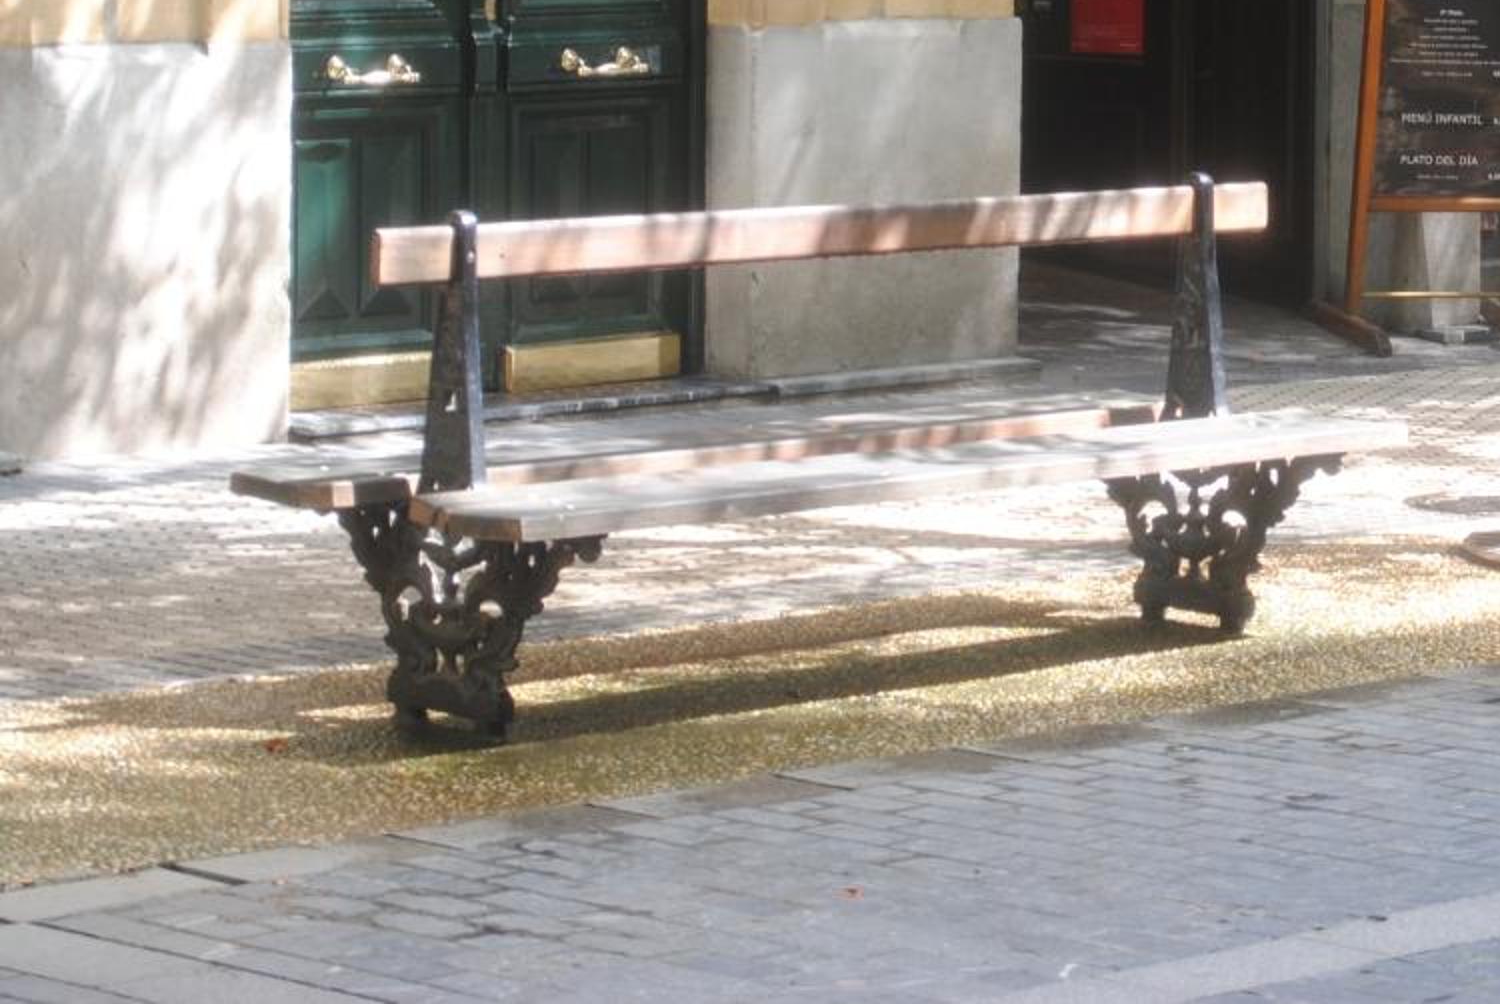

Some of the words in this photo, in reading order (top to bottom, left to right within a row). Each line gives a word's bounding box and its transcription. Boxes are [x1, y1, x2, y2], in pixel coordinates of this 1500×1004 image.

[1401, 110, 1433, 125] MENÚ
[1435, 112, 1484, 126] INFANTIL
[1400, 154, 1434, 166] PLATO
[1435, 155, 1457, 166] DEL
[1458, 153, 1479, 166] DÍA
